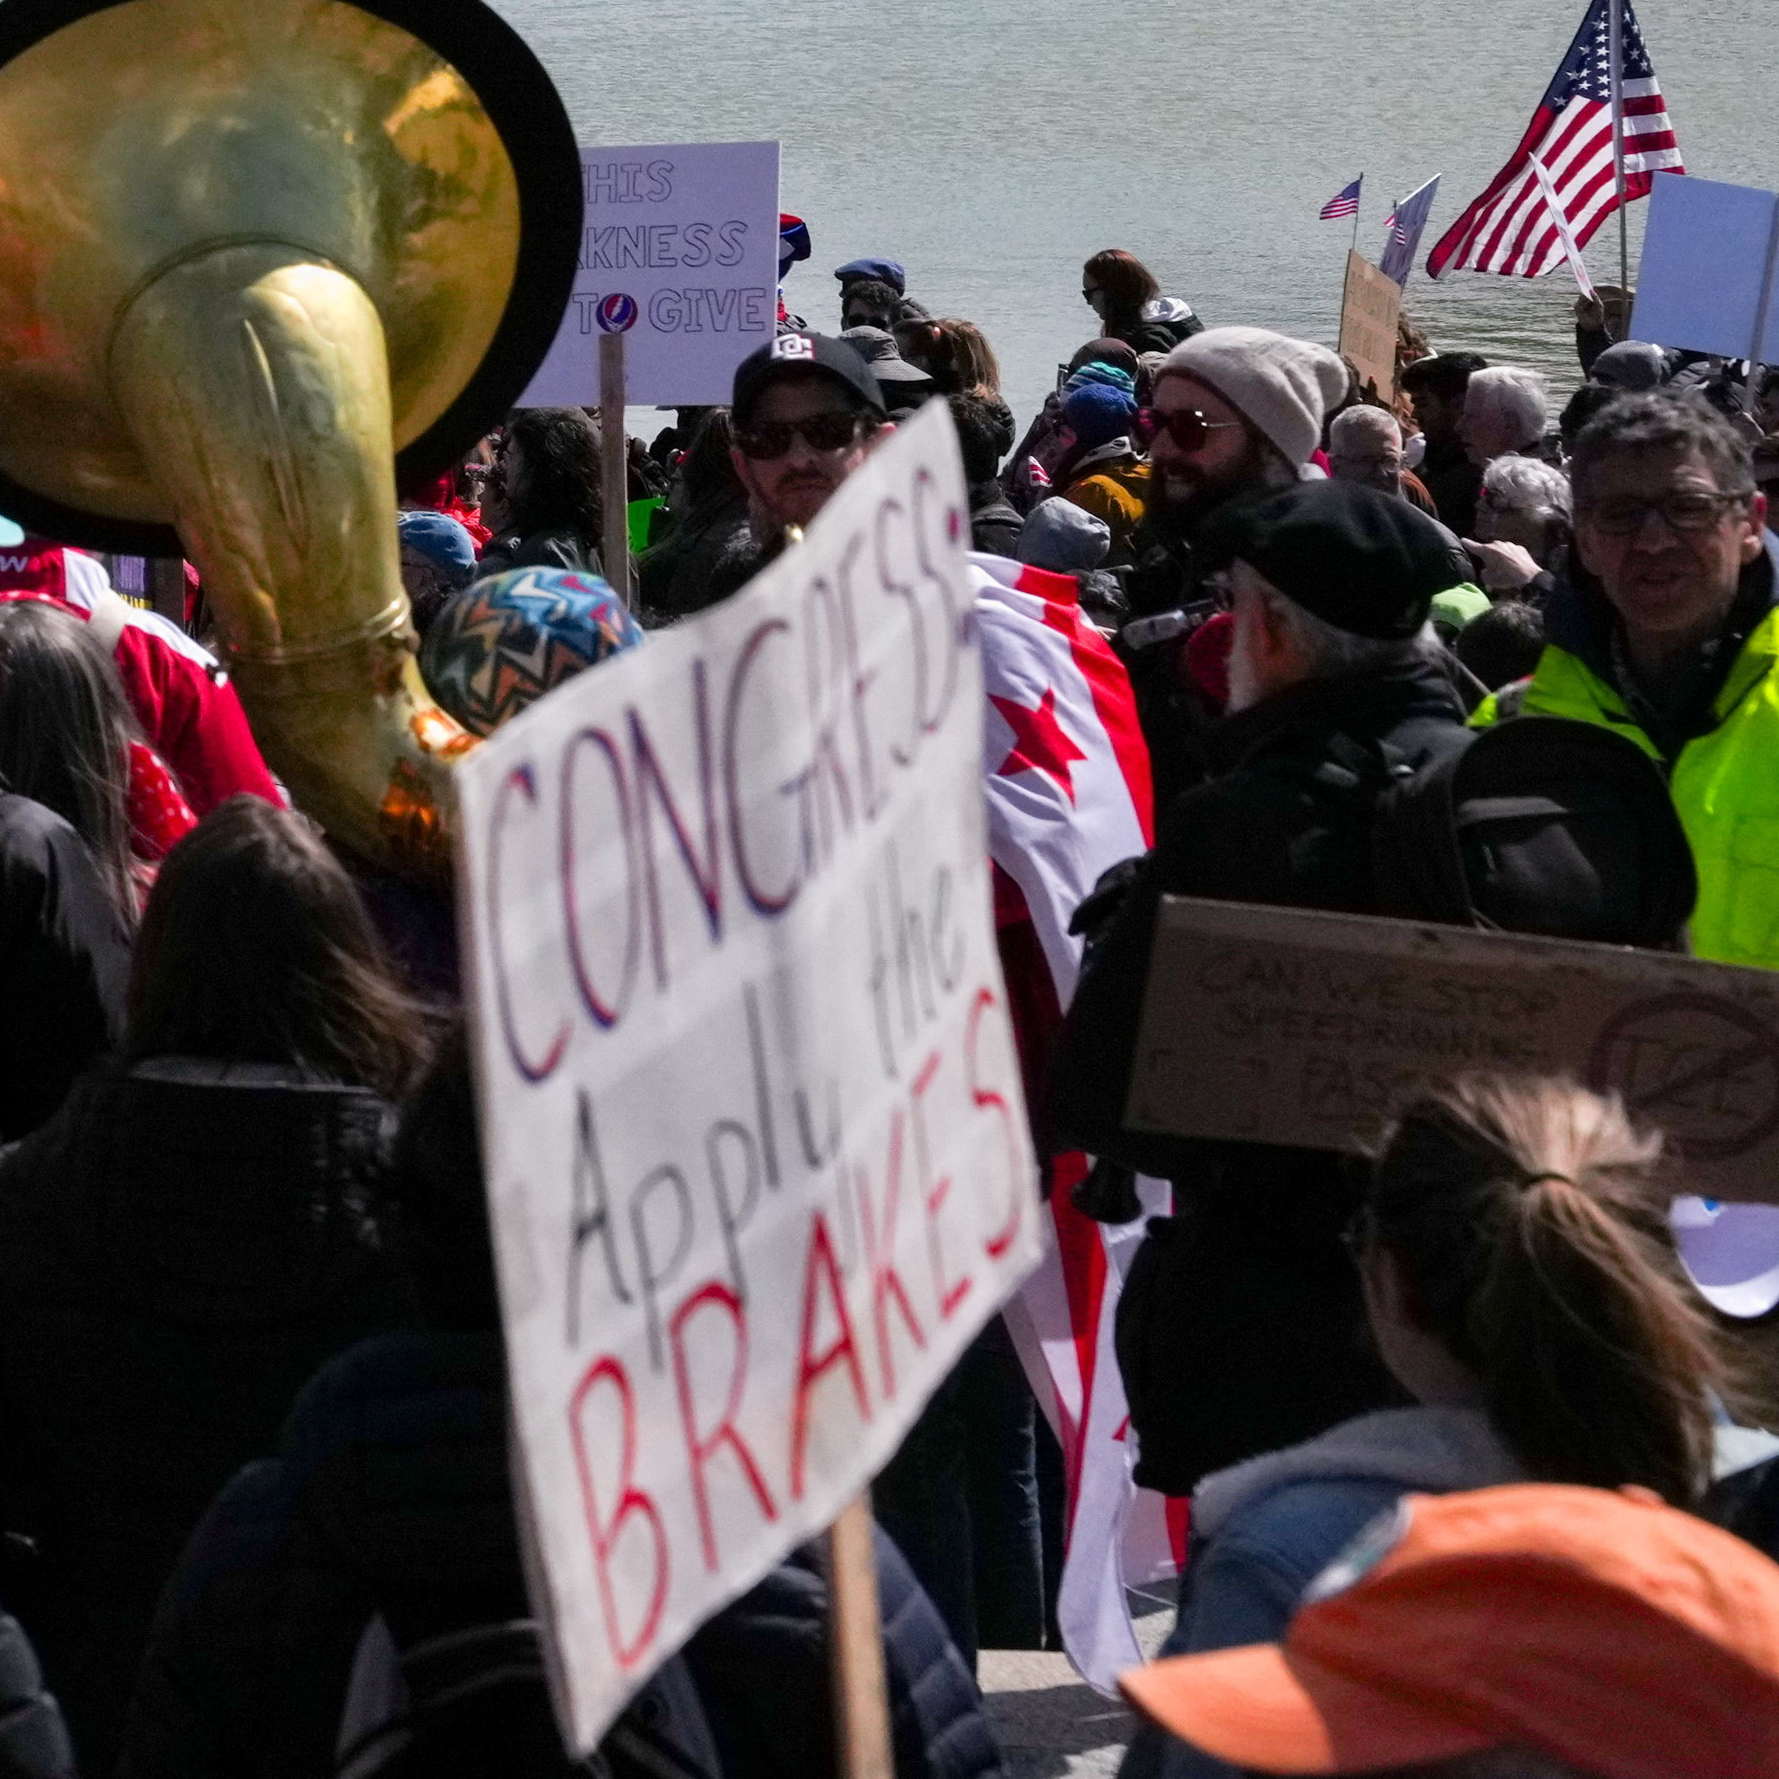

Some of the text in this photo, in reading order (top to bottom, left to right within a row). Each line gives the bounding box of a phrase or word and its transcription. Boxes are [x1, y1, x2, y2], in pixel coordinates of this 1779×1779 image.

[580, 159, 676, 205] HIS
[574, 220, 748, 271] KNESS
[647, 287, 767, 334] GIVE
[1199, 952, 1560, 1023] CAN WE STOP
[1299, 1052, 1398, 1110] FAS
[568, 987, 1026, 1670] BRAKES
